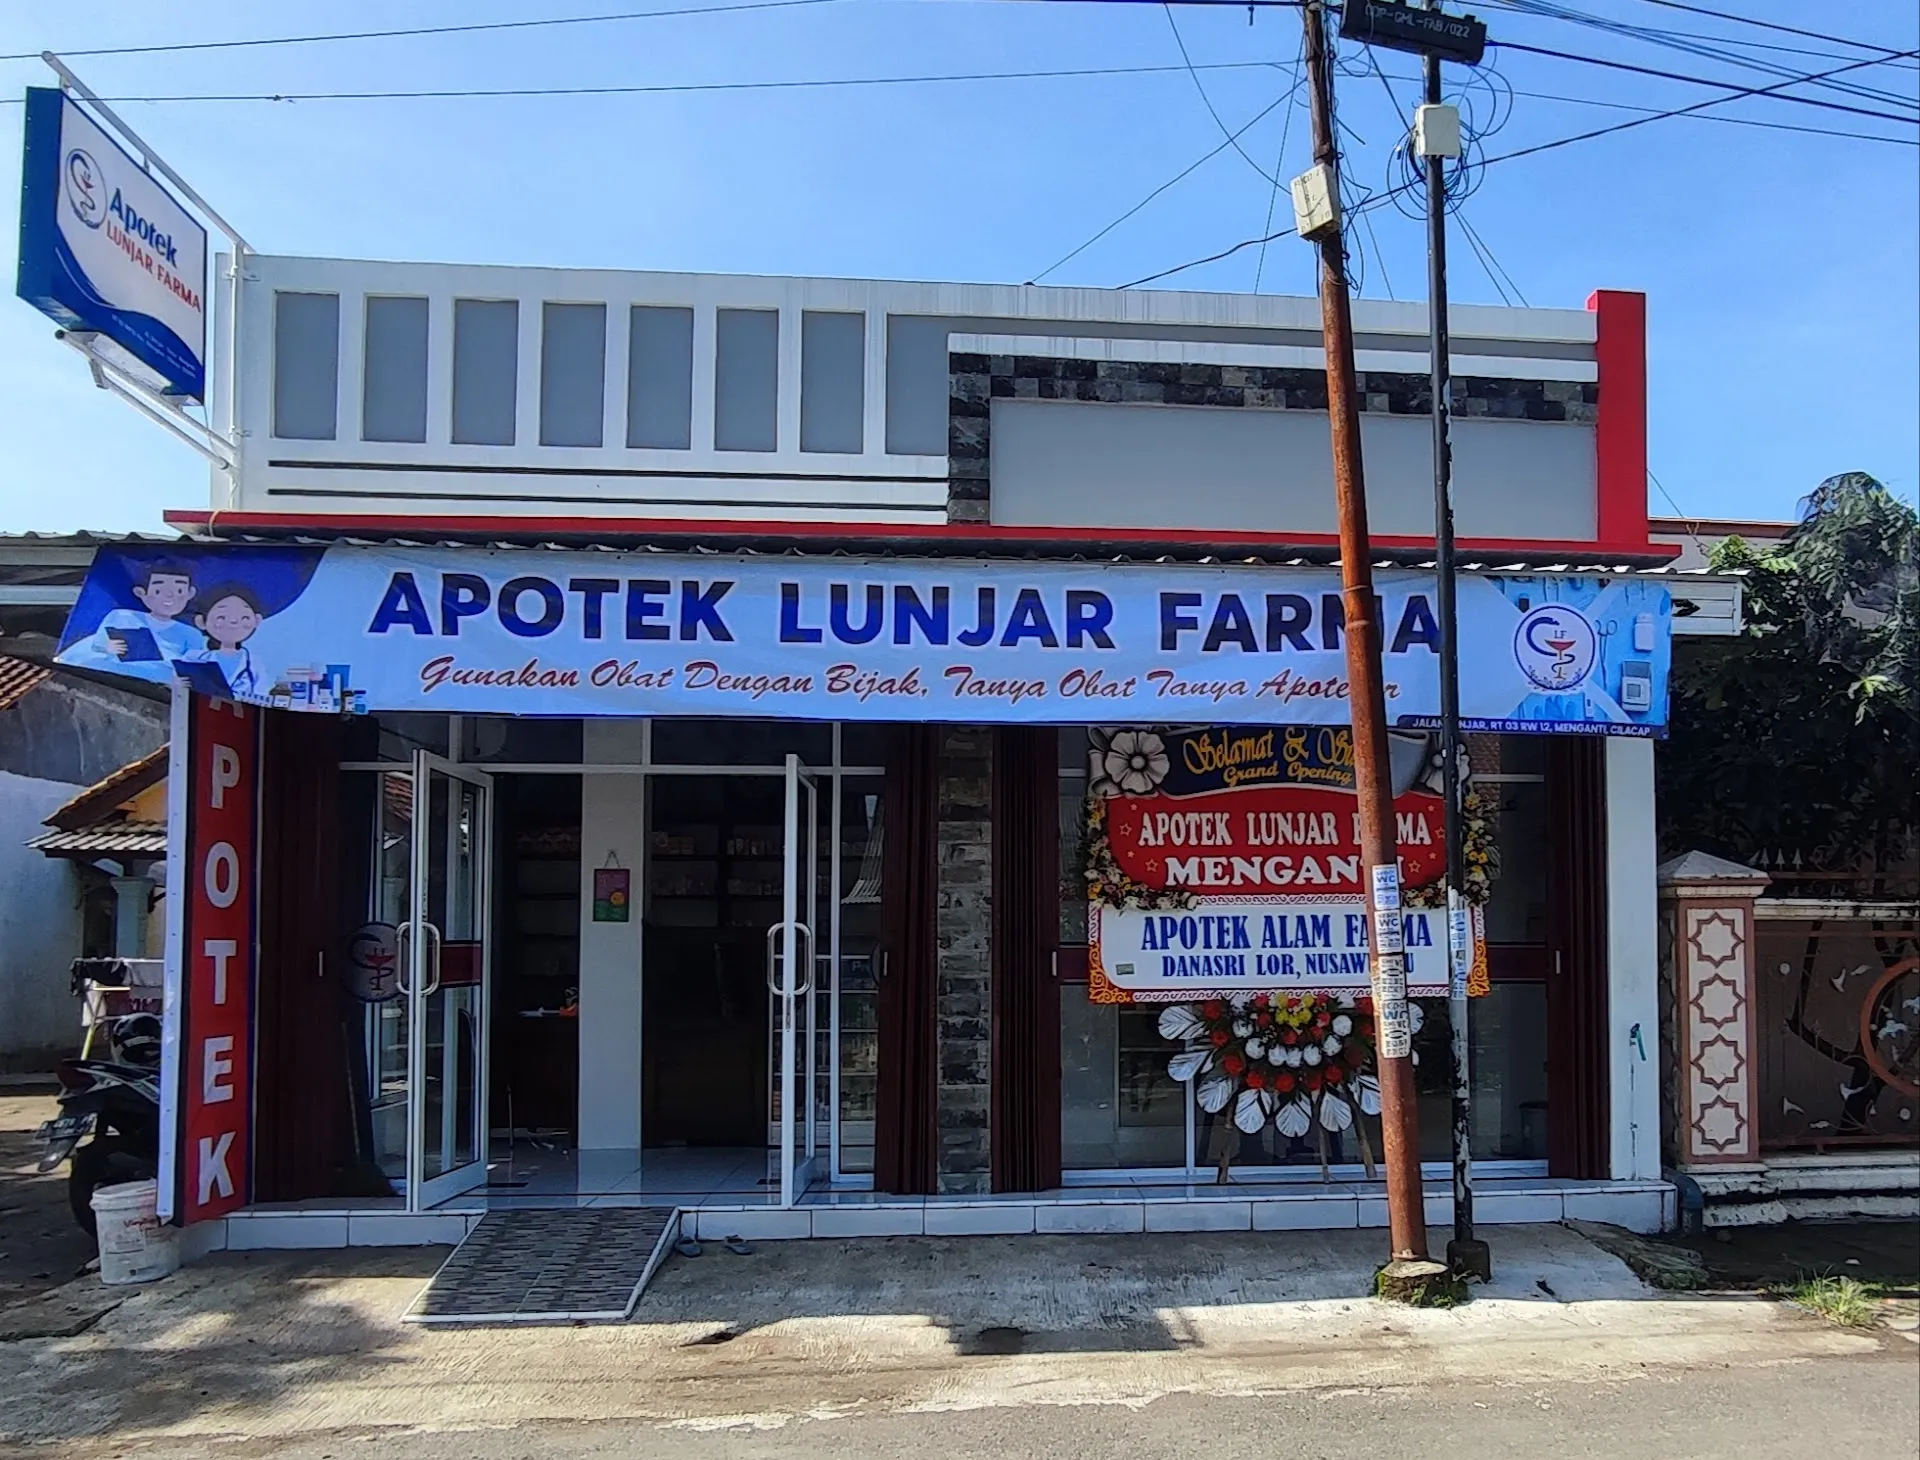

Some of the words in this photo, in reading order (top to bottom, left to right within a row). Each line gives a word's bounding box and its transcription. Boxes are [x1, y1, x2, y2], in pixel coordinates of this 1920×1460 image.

[110, 188, 177, 268] Apotek
[107, 219, 153, 275] LUNJAR
[157, 263, 201, 312] FARMA
[367, 571, 736, 642] APOTEK
[779, 582, 1116, 650] LUNJAR
[1553, 629, 1568, 639] LF
[420, 655, 580, 694] Gunakan
[590, 659, 675, 689] Obat
[685, 661, 812, 701] Dengan
[825, 664, 928, 703] Bijak,
[943, 665, 1050, 707] Tanya
[1059, 668, 1136, 700] Obat
[1146, 671, 1249, 707] Tanya
[1255, 670, 1401, 704] Apoter
[1491, 721, 1503, 730] RT
[1505, 722, 1519, 731] 03
[1520, 722, 1538, 732] RW
[1540, 722, 1553, 733] 12,
[1555, 723, 1608, 735] MENGANTI,
[1610, 726, 1651, 736] CILACAP
[1183, 729, 1275, 775] Selamat
[1282, 726, 1309, 763] &
[1223, 760, 1279, 788] Grand
[1287, 761, 1354, 786] Opening
[1138, 811, 1233, 846] APOTEK
[1247, 811, 1340, 845] LUNJAR
[1376, 875, 1396, 883] WC
[1141, 915, 1252, 951] APOTEK
[1262, 914, 1333, 949] ALAM
[1379, 918, 1399, 927] WC
[1162, 952, 1246, 977] DANASRI
[1255, 953, 1301, 980] LOR,
